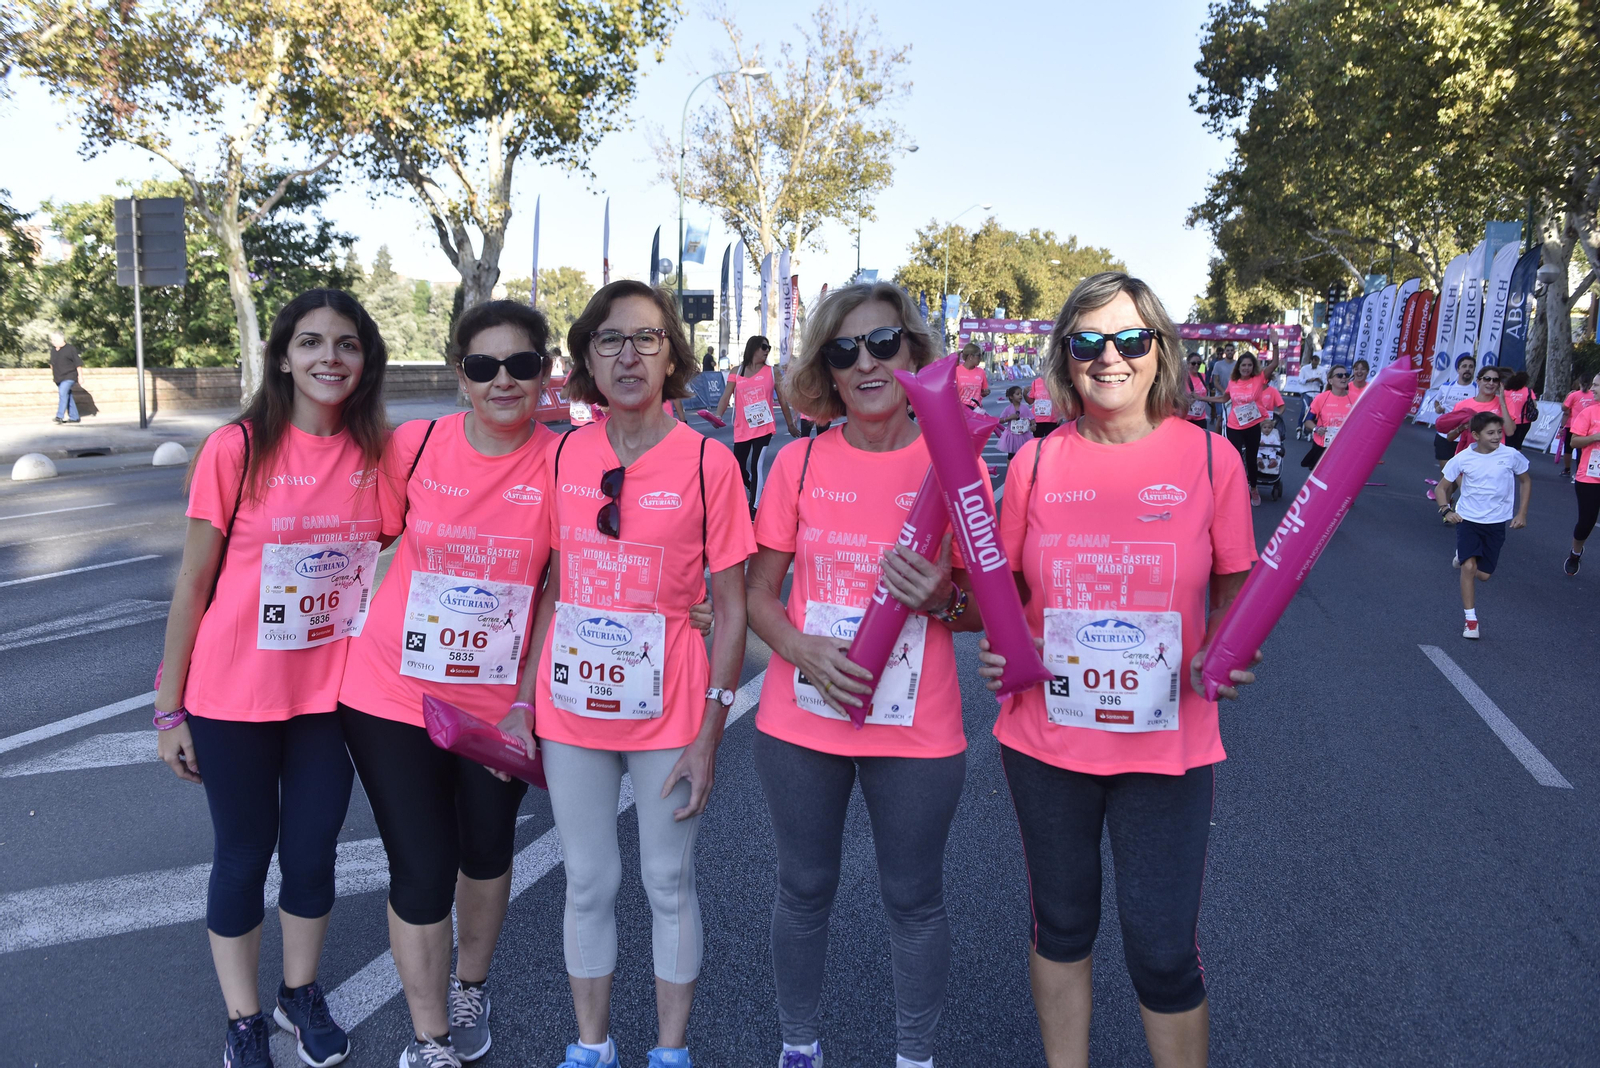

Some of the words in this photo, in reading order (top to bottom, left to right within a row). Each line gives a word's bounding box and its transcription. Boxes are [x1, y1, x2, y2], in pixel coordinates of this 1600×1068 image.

[1464, 278, 1476, 344] ZURICH
[1506, 292, 1525, 340] ABC
[1403, 300, 1416, 341] Santander
[1415, 299, 1430, 352] Santander
[708, 380, 720, 392] ABC
[752, 412, 764, 420] 016
[266, 474, 316, 488] OYSHO
[422, 478, 469, 497] OYSHO
[506, 491, 542, 501] ASTURIANA
[562, 484, 606, 500] OYSHO
[812, 488, 857, 503] OYSHO
[1045, 489, 1096, 503] OYSHO
[1142, 491, 1182, 501] ASTURIANA
[272, 517, 296, 532] HOY
[302, 515, 340, 529] GANAN
[958, 479, 1007, 573] Ladival
[1260, 474, 1328, 570] Ladival
[415, 519, 433, 534] HOY
[437, 523, 476, 540] GANAN
[827, 531, 868, 547] GANAN
[920, 534, 932, 554] SOLAR
[1039, 534, 1062, 548] HOY
[1067, 534, 1110, 548] GANAN
[447, 544, 479, 554] VITORIA
[487, 548, 520, 558] GASTEIZ
[583, 548, 610, 561] VITORIA
[618, 554, 650, 566] GASTEIZ
[837, 551, 869, 562] VITORIA
[464, 554, 496, 565] MADRID
[597, 560, 627, 572] MADRID
[1078, 554, 1113, 563] VITORIA
[1122, 555, 1160, 565] GASTEIZ
[300, 562, 345, 573] ASTURIANA
[1096, 564, 1134, 574] MADRID
[1296, 559, 1312, 581] SOLAR
[299, 591, 339, 614] 016
[444, 593, 494, 608] ASTURIANA
[597, 594, 612, 606] LAS
[310, 614, 330, 626] 5836
[440, 628, 488, 649] 016
[580, 625, 627, 642] ASTURIANA
[1082, 630, 1140, 643] ASTURIANA
[449, 652, 474, 662] 5835
[611, 648, 635, 656] Carrera
[1122, 651, 1149, 659] Carrera
[407, 661, 434, 671] OYSHO
[579, 660, 625, 684] 016
[1083, 668, 1139, 691] 016
[588, 685, 612, 696] 1396
[555, 692, 577, 704] OYSHO
[800, 695, 826, 707] OYSHO
[1099, 695, 1121, 706] 996
[1053, 707, 1083, 717] OYSHO
[1106, 713, 1129, 721] Santander
